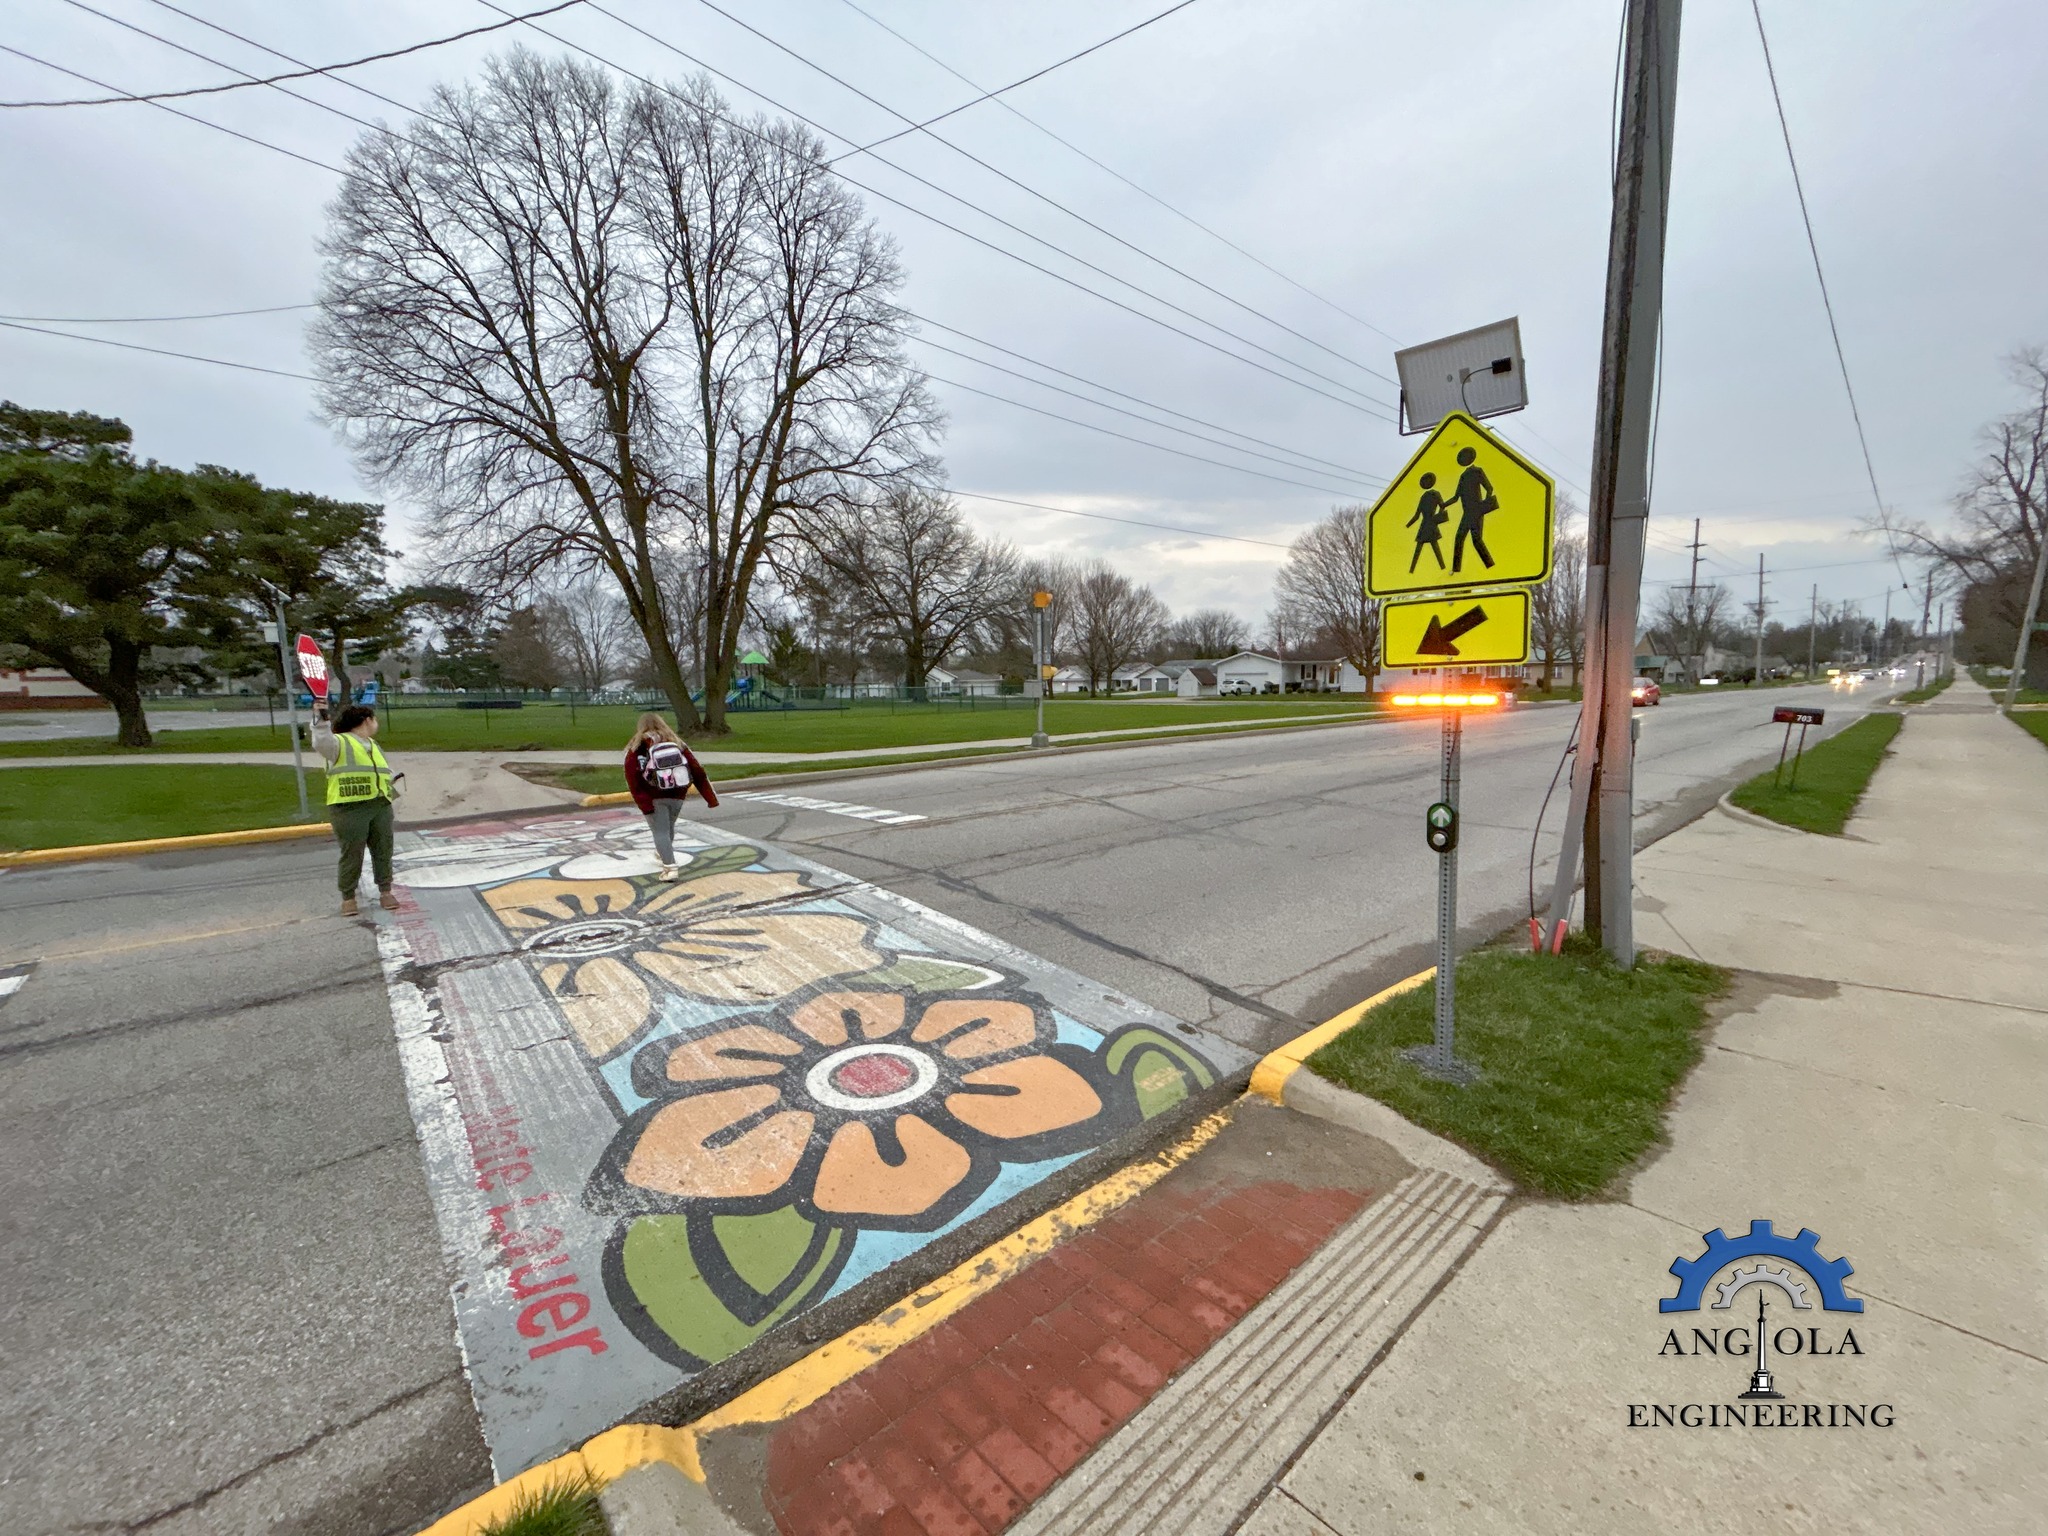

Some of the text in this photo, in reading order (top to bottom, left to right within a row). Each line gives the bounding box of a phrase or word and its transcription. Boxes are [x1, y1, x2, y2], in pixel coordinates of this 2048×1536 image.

[298, 652, 327, 681] STOP
[1796, 714, 1813, 723] 703
[338, 776, 371, 785] CROSSING
[339, 784, 371, 797] GUARD
[486, 1191, 609, 1361] Lauer
